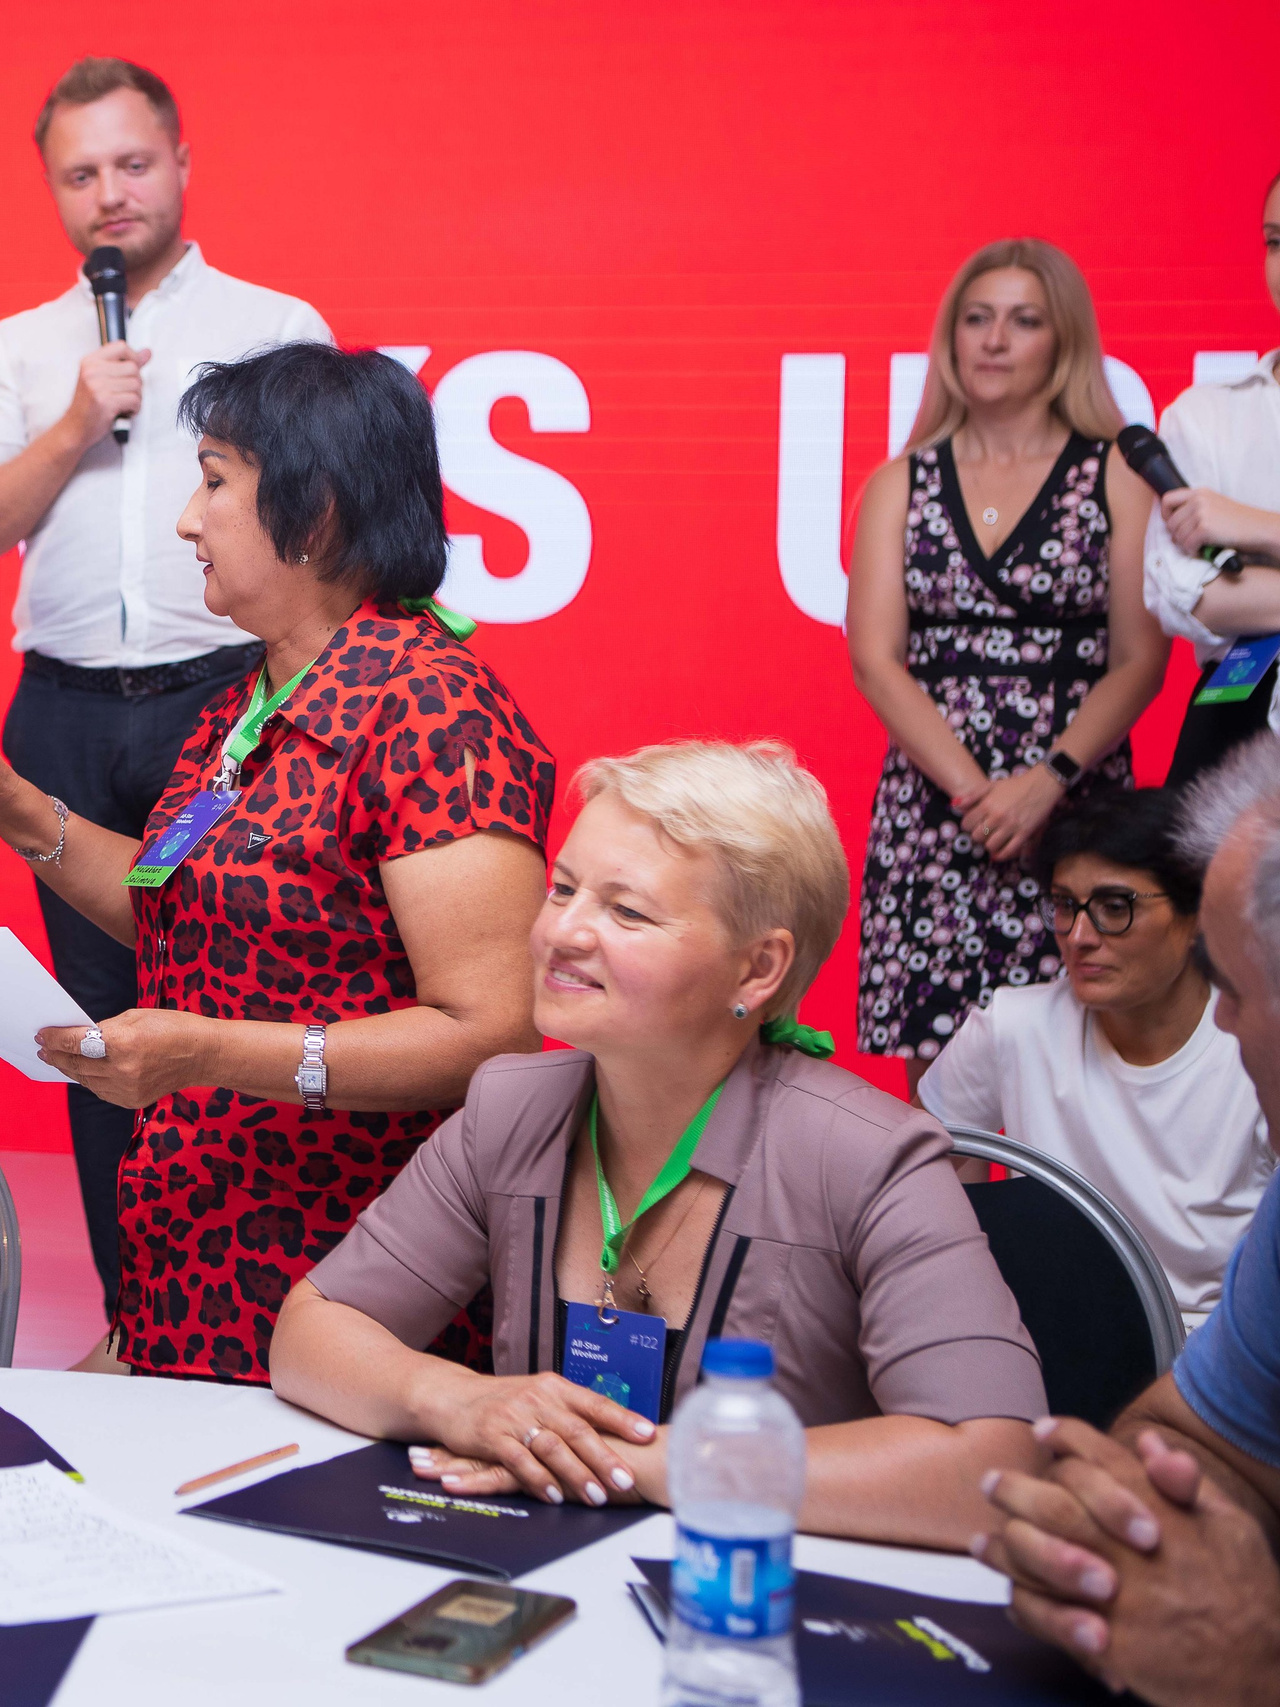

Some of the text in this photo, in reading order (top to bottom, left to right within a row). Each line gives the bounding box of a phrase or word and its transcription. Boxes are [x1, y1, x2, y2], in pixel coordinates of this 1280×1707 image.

[571, 1338, 602, 1352] All-Star
[629, 1333, 659, 1351] #122
[570, 1347, 609, 1363] Weekend
